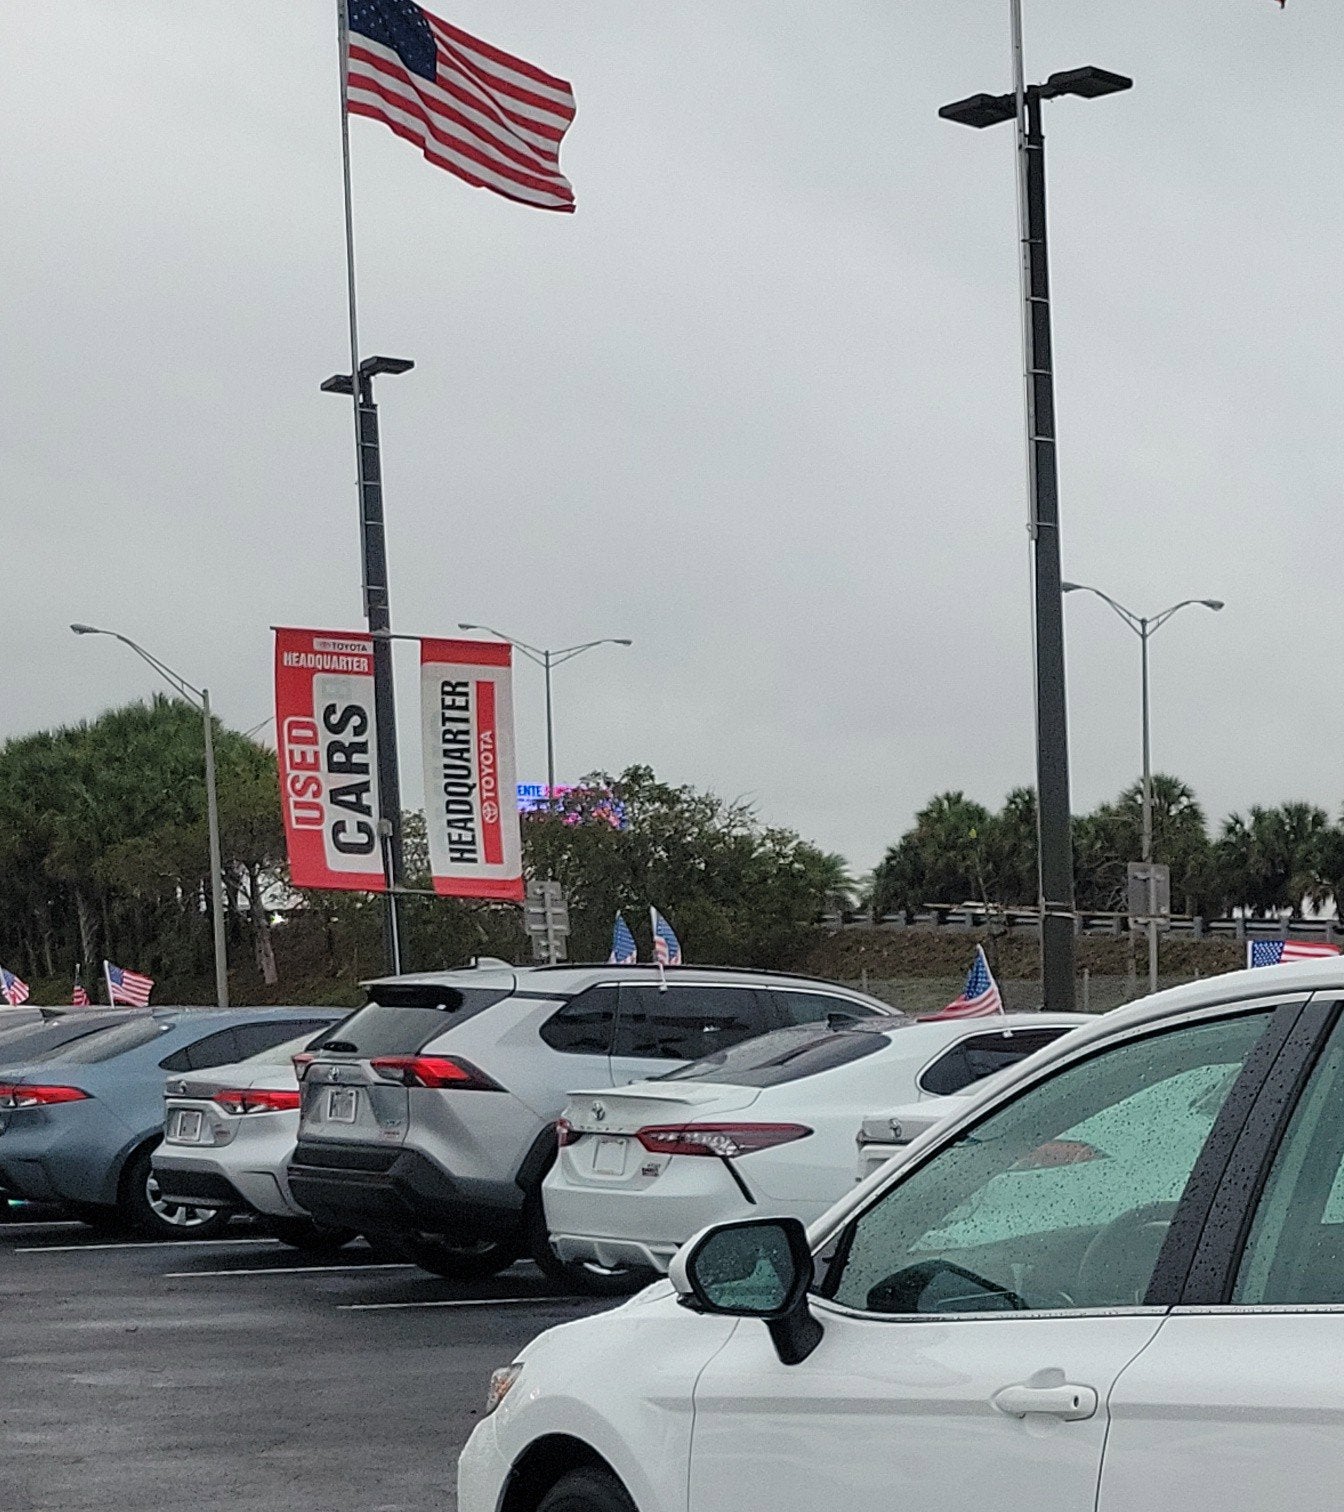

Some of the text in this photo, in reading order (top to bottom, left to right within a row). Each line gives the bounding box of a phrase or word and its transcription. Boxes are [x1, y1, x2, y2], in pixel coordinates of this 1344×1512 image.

[283, 651, 368, 672] HEADQUARTER
[331, 641, 368, 652] TOYOTA
[283, 716, 325, 829] USED
[323, 702, 375, 855] CARS
[441, 680, 478, 864] HEADQUARTER
[479, 731, 499, 800] TOYOTA
